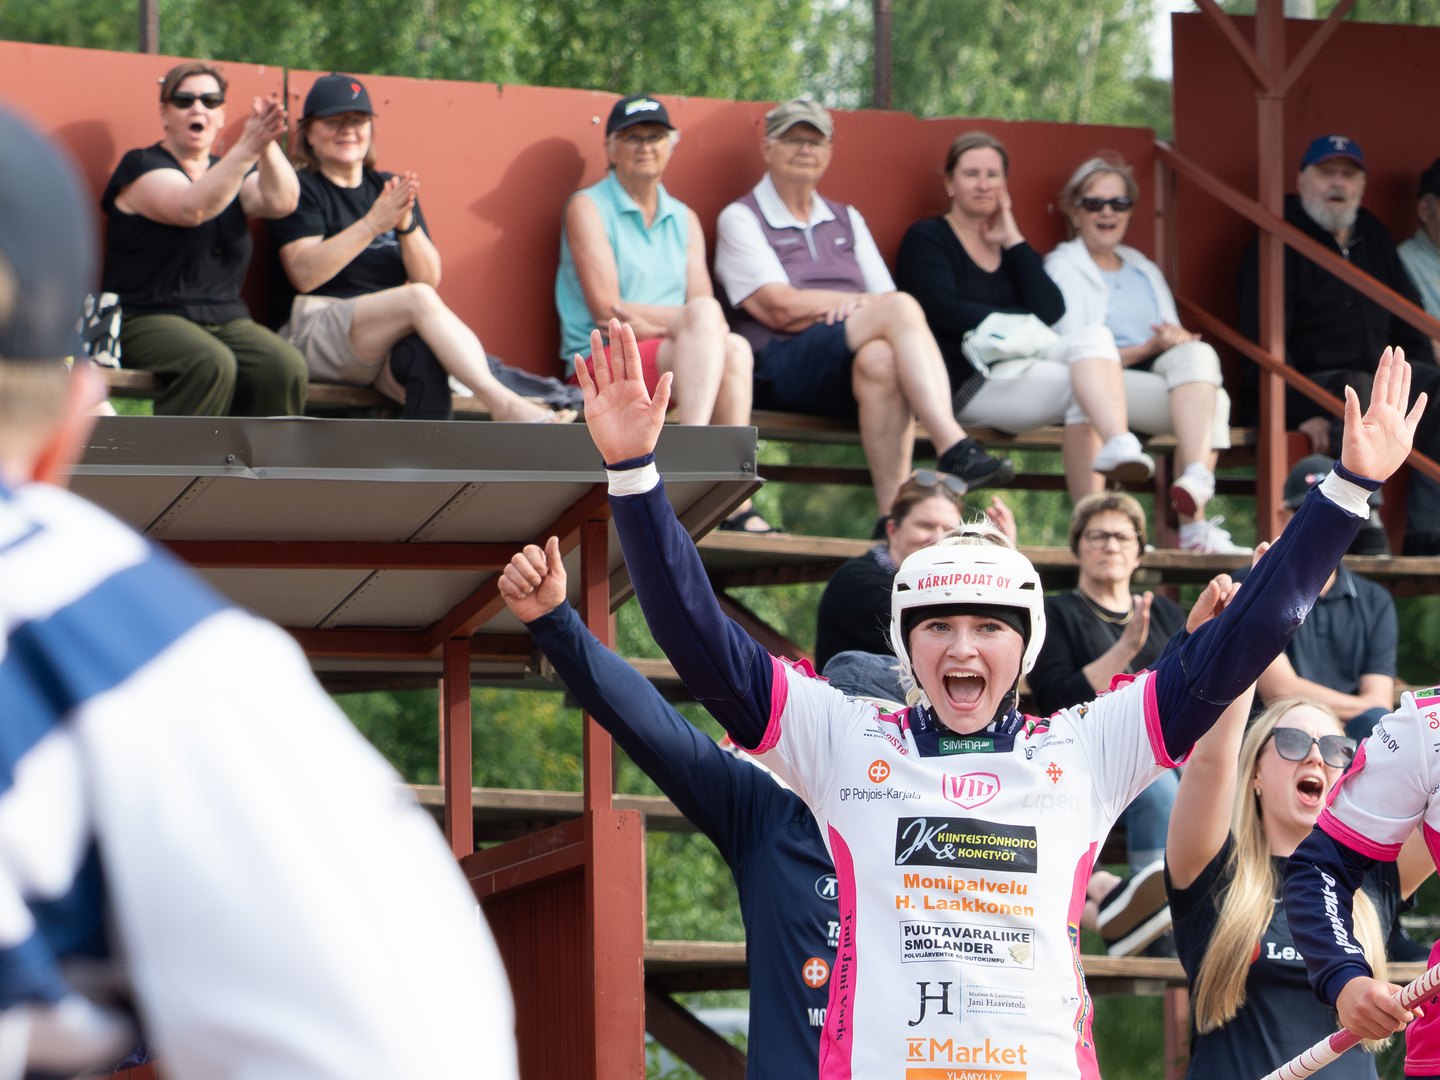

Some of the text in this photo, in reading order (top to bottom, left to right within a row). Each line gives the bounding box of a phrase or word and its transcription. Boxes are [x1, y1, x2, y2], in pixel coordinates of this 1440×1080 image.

[917, 572, 1012, 591] KÄRRIPOJAT OY
[853, 787, 921, 802] Pohjois-Karjala
[937, 832, 1037, 849] KIINTEISTÖNHOITO
[958, 848, 1016, 862] KONETYÖT
[903, 873, 1028, 896] Monipalvelu
[895, 895, 1034, 917] H. Laakkonen
[904, 925, 1030, 943] PUUTAVARALIIKE
[904, 938, 994, 954] SMOLANDER
[968, 999, 1026, 1009] Jani Haavistola
